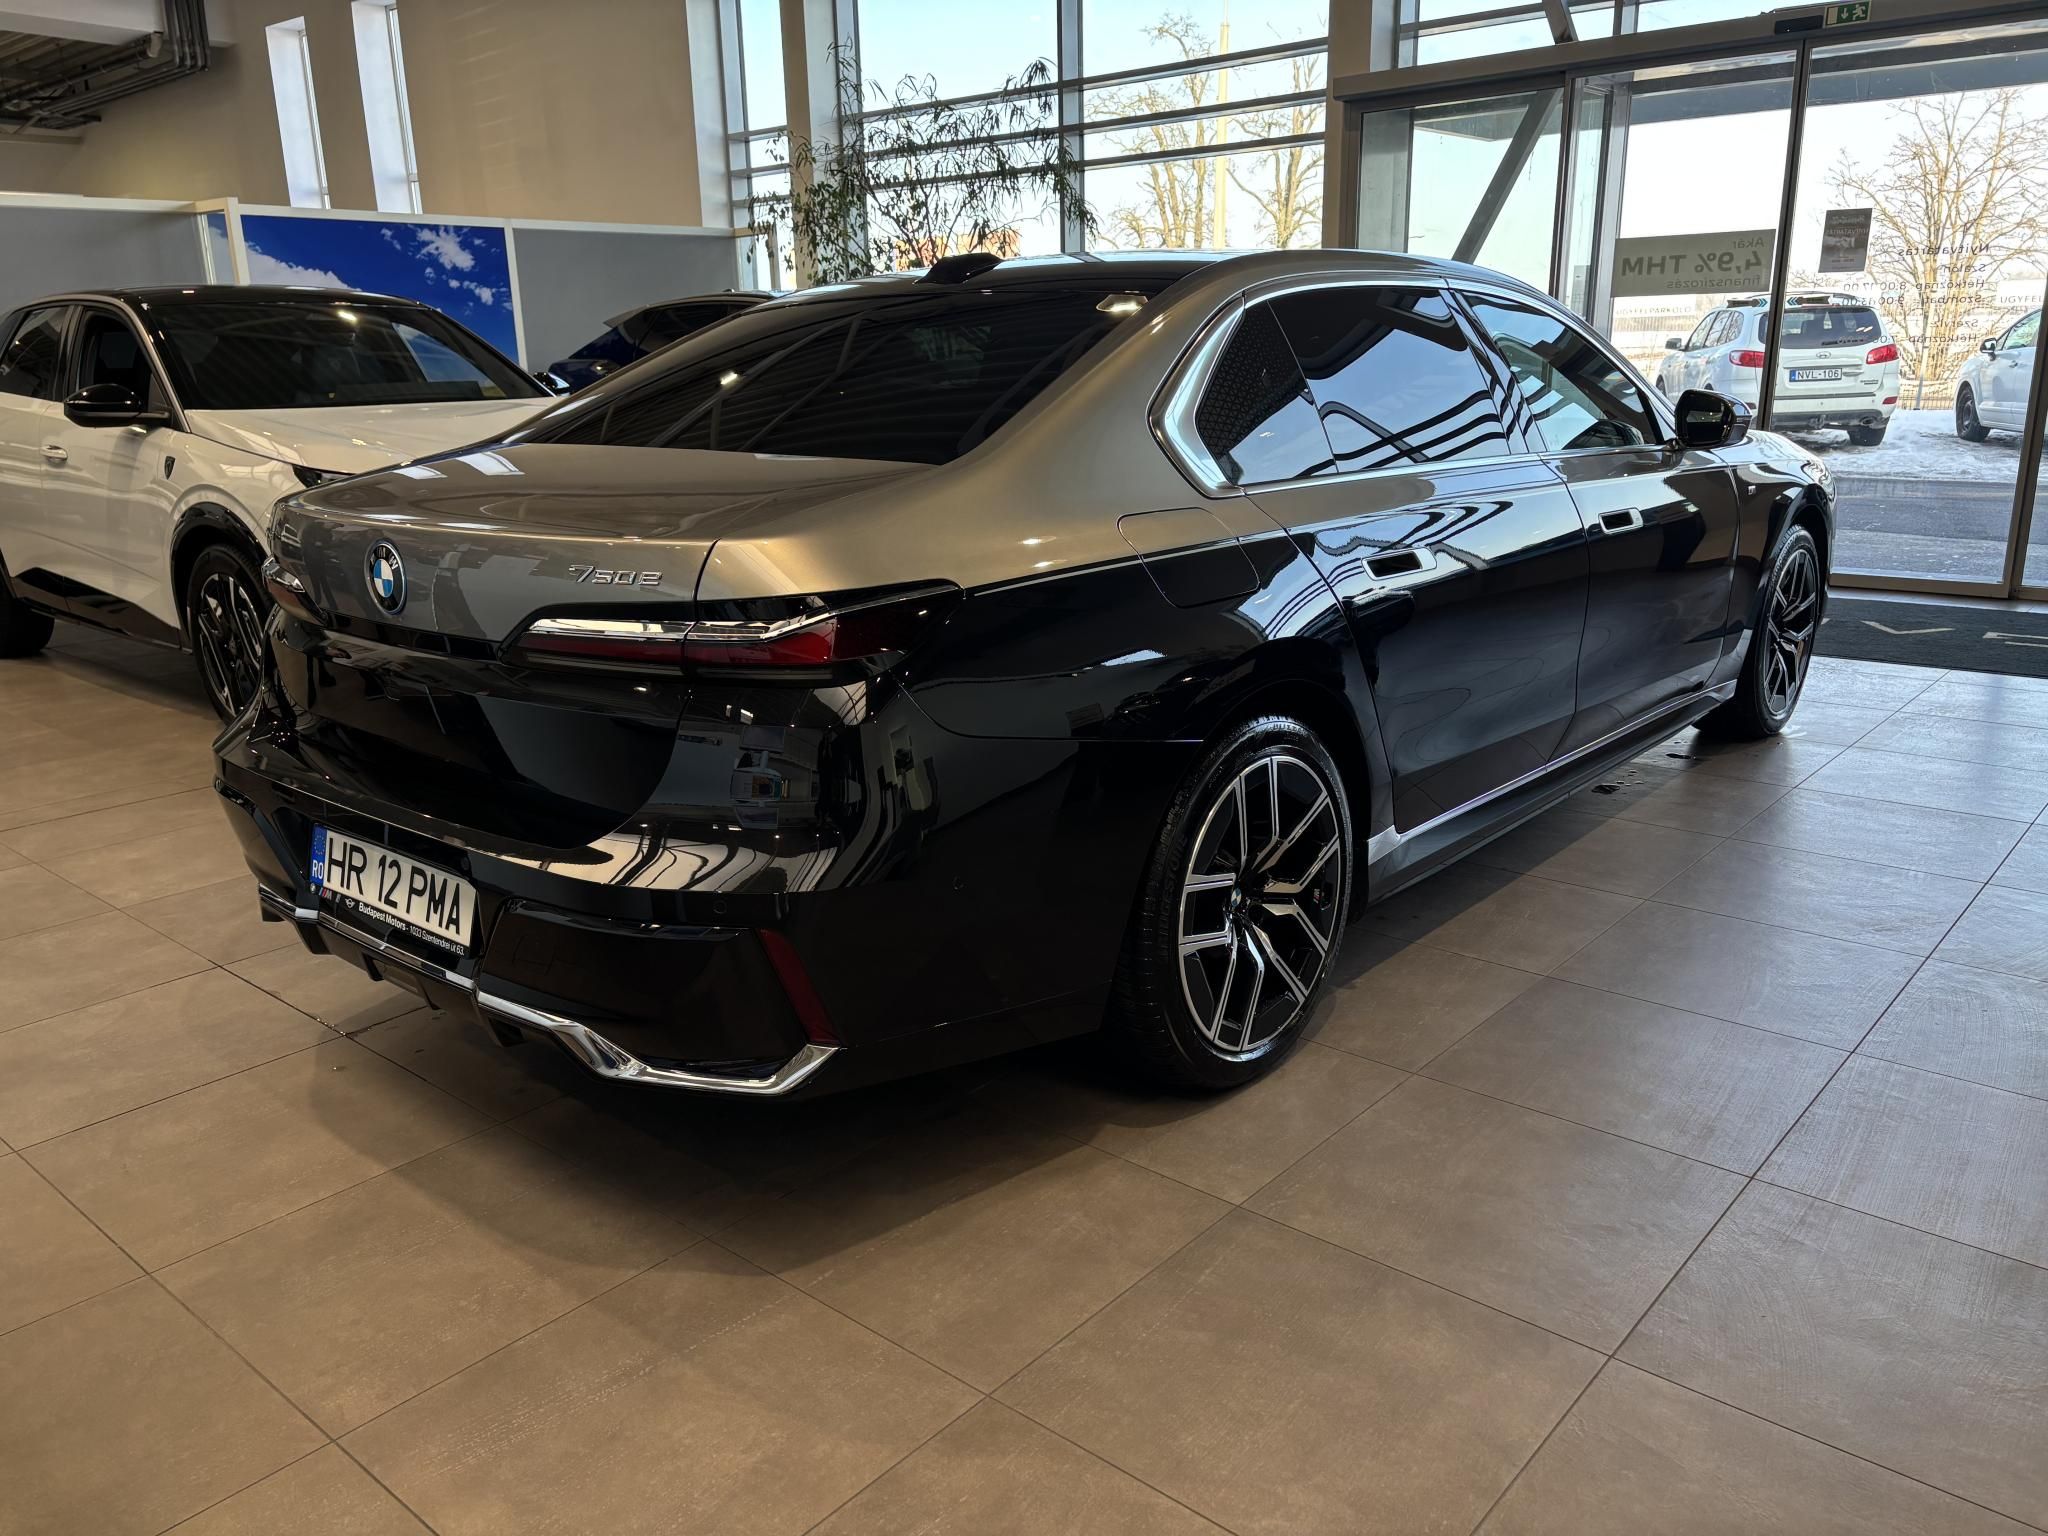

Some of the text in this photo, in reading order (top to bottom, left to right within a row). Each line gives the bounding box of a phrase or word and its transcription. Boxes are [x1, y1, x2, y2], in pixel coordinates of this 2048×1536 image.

[1797, 369, 1840, 380] NVL-106
[370, 546, 399, 570] BMW
[312, 860, 324, 880] RO
[326, 837, 461, 936] HR 12 PMA
[358, 902, 386, 922] Budapest
[385, 913, 406, 931] Motors
